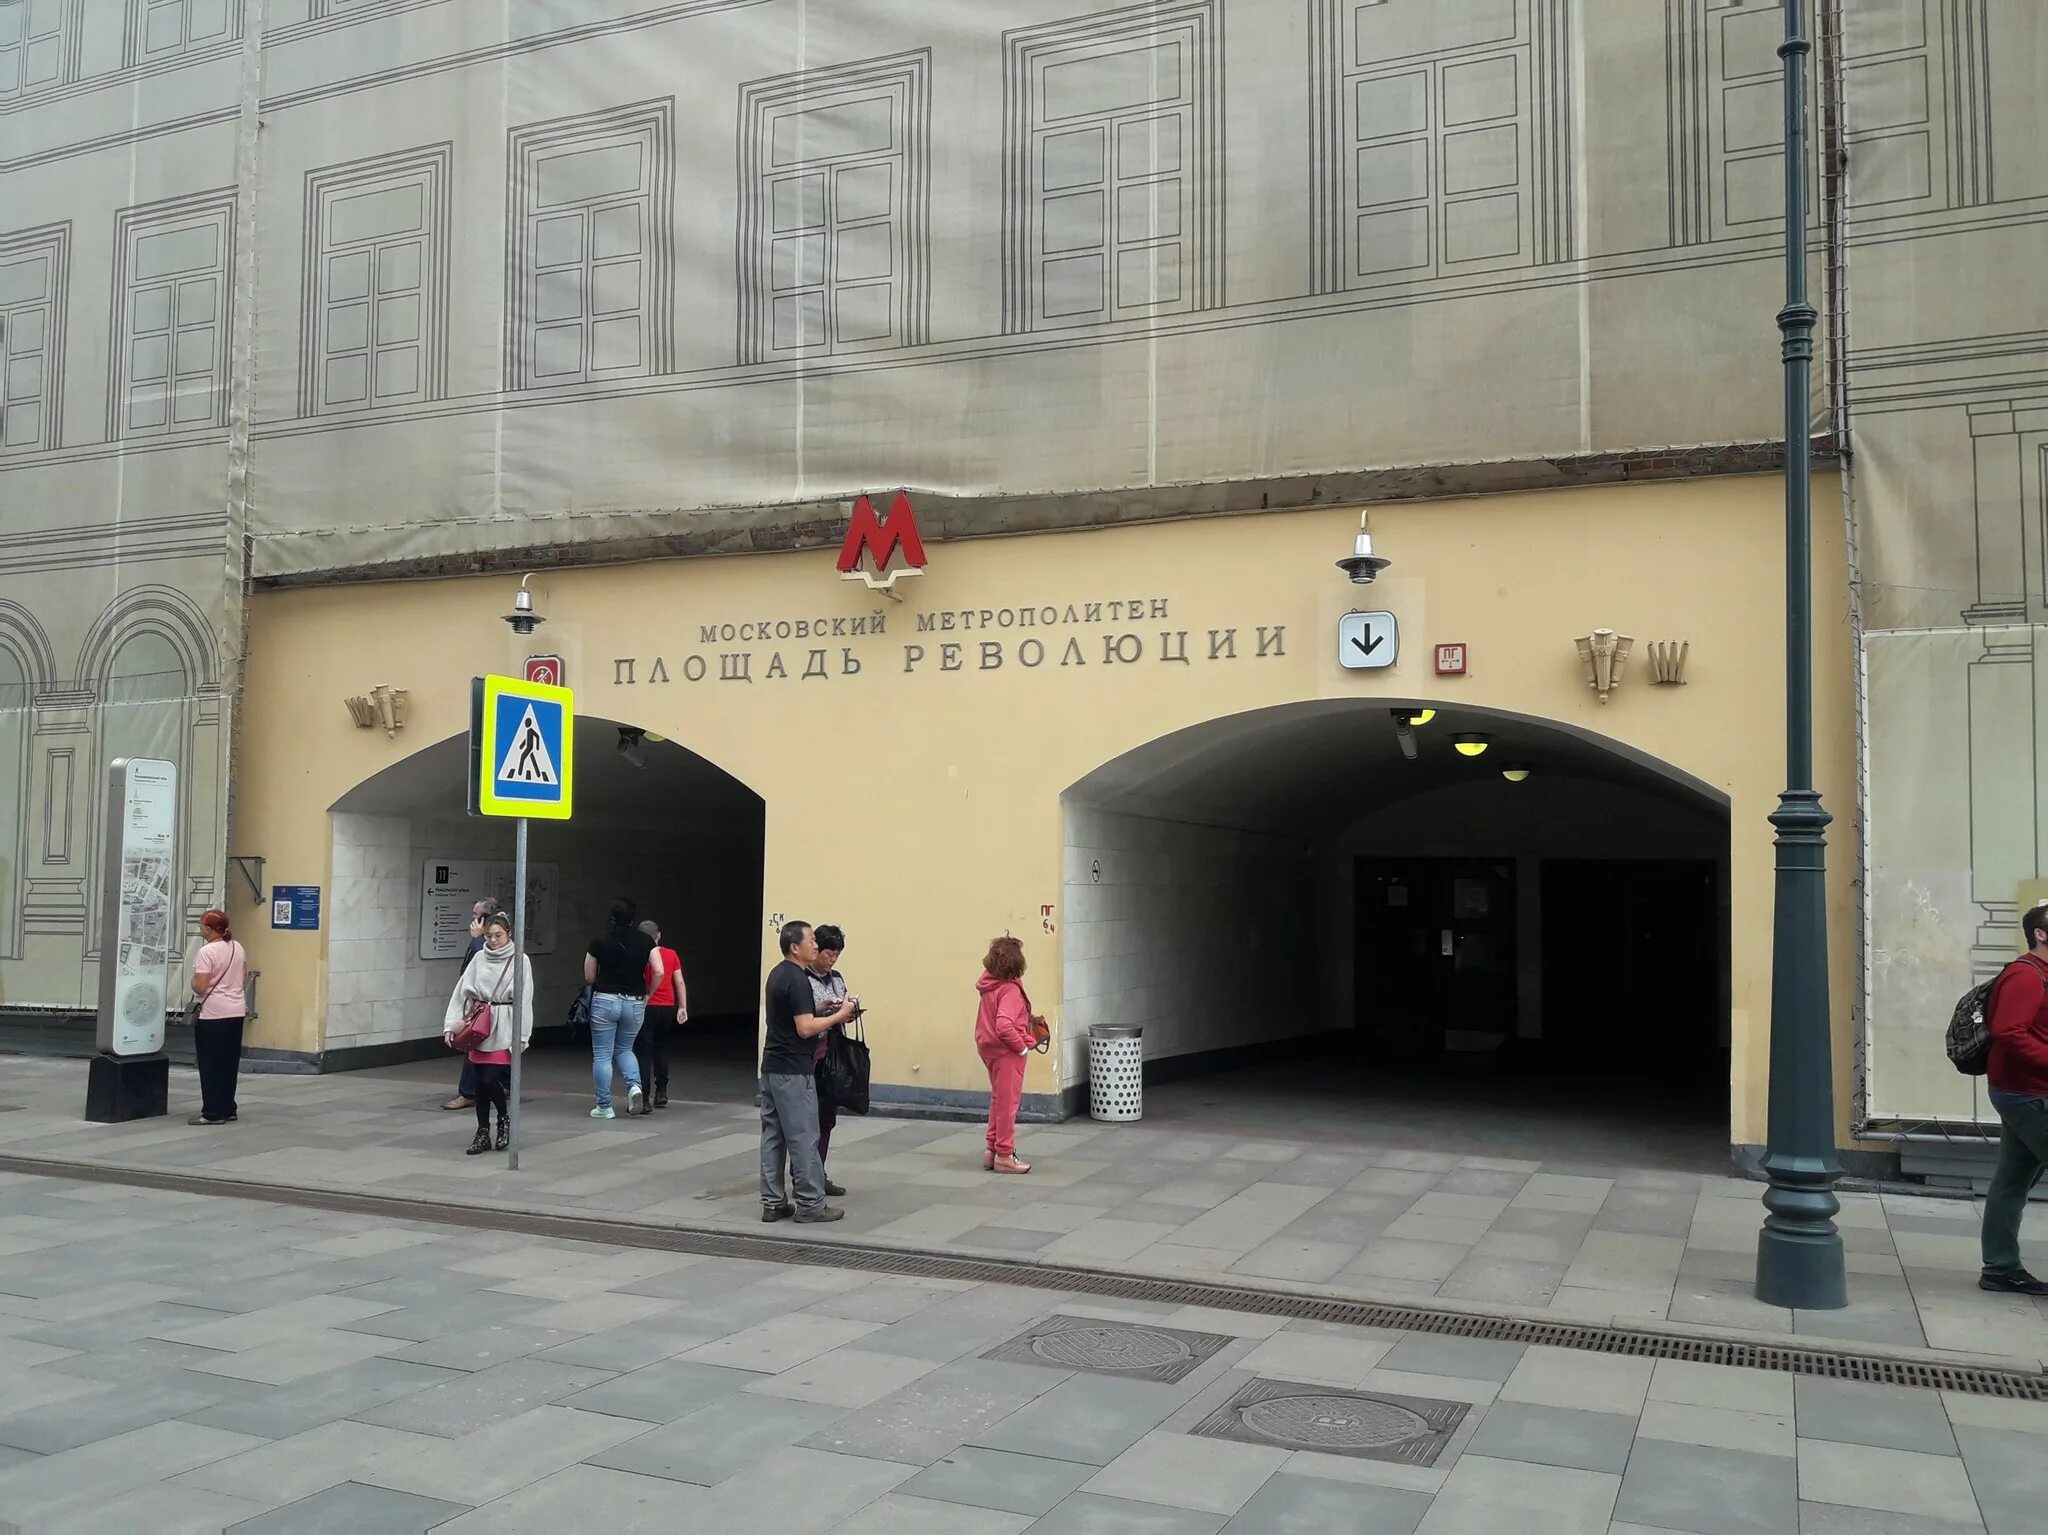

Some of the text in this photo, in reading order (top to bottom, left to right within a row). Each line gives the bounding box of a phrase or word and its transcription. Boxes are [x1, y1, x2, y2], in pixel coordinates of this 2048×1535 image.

[700, 598, 1169, 643] МОСКОВСКИЙ МЕТРОПОЛИТЕН
[613, 625, 1286, 685] ПЛОЩАДЬ РЕВОЛЮЦИИ
[1444, 648, 1458, 659] ПГ
